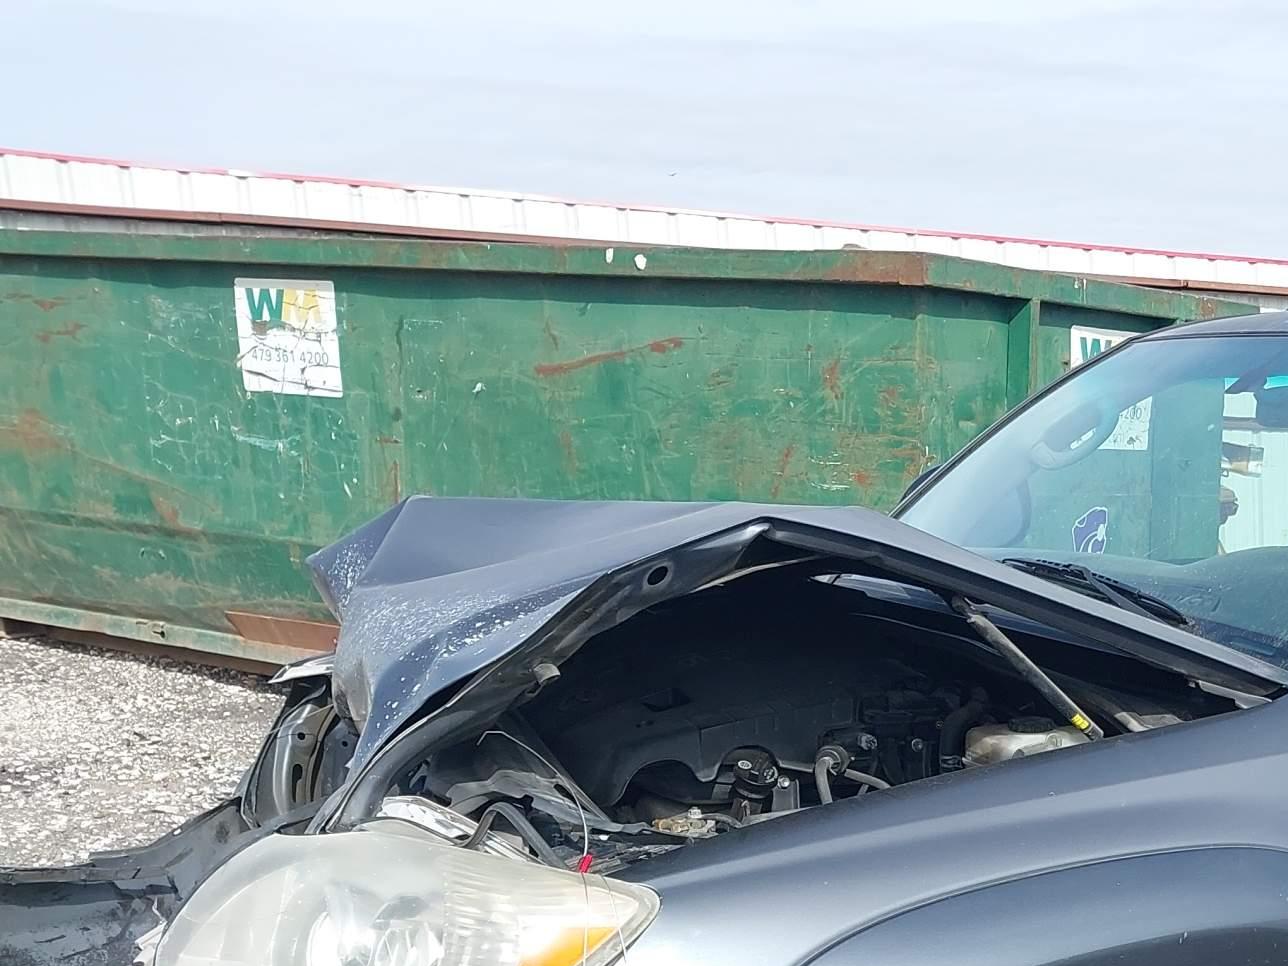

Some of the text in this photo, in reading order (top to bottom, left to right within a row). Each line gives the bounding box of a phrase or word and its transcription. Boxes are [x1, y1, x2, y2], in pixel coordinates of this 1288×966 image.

[245, 288, 322, 322] WM
[252, 348, 329, 365] 479 361 4200
[1080, 336, 1114, 361] W
